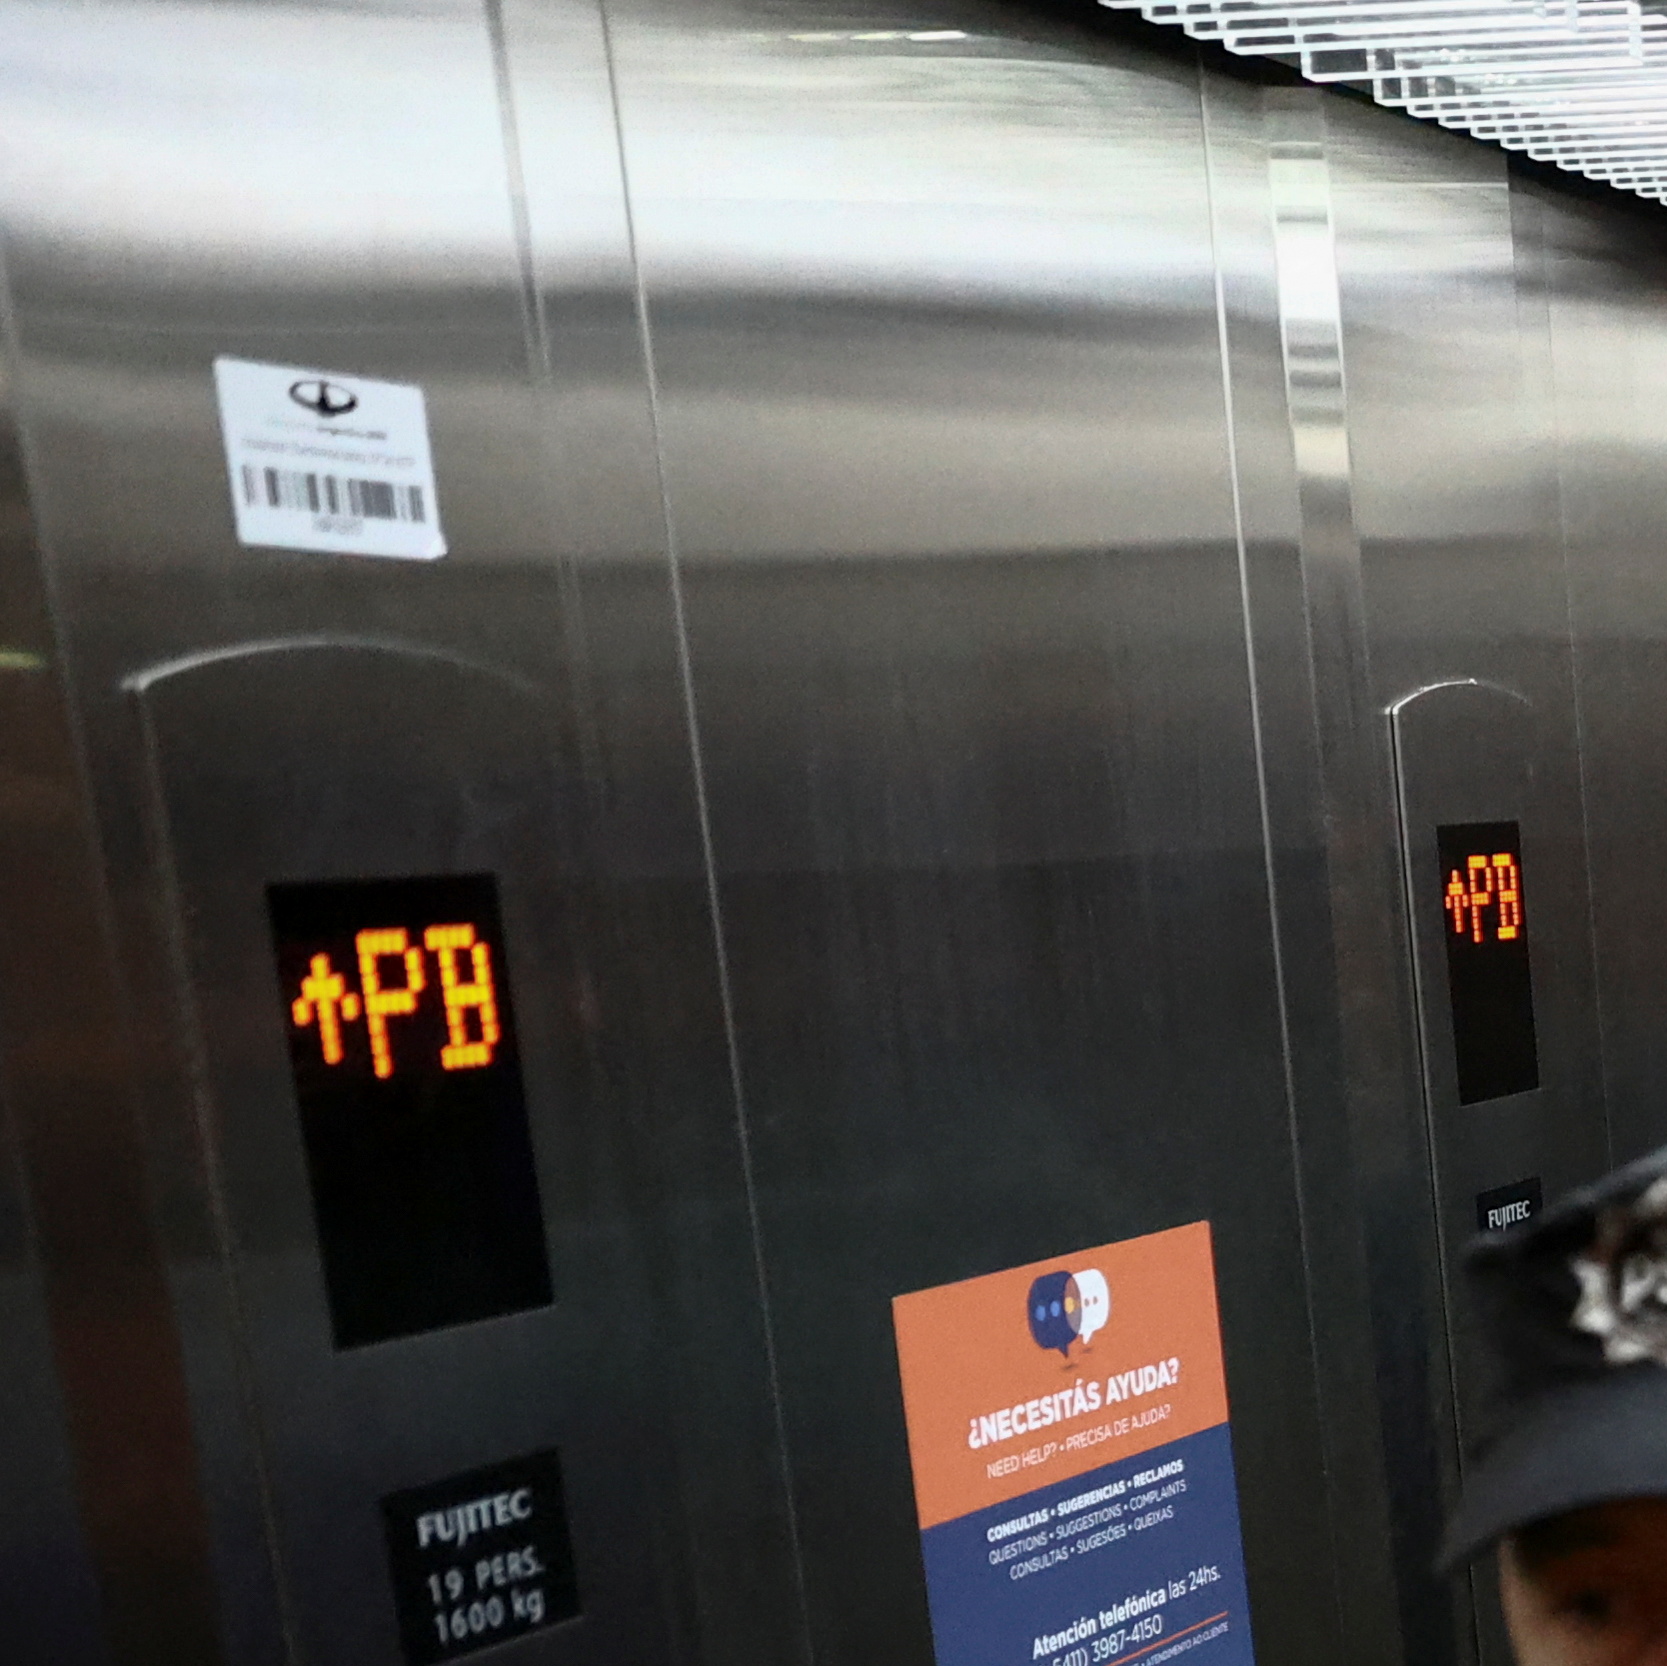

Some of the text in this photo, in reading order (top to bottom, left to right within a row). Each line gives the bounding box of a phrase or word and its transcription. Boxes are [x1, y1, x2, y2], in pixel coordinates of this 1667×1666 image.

[1468, 853, 1520, 943] PB
[355, 921, 500, 1079] PB
[1487, 1200, 1531, 1231] FUJITEC
[967, 1356, 1180, 1449] ¿NECESITÁS AYUDA?
[986, 1403, 1171, 1479] NEED HELP? PRECISA DE AJUDA?
[415, 1487, 533, 1547] FUJITEC
[986, 1458, 1185, 1543] CONSULTAS SUGERENCIAS RECLAMOS
[988, 1478, 1187, 1565] QUESTIONS SUGGESTIONS COMPLAINTS
[1009, 1545, 1069, 1580] CONSULTAS
[1133, 1504, 1174, 1531] QUEIXAS
[427, 1567, 465, 1606] 19
[435, 1587, 546, 1643] 1600 kg
[1032, 1564, 1222, 1660] Atención telefónica las 24hs.
[1091, 1613, 1164, 1663] 3987-4150
